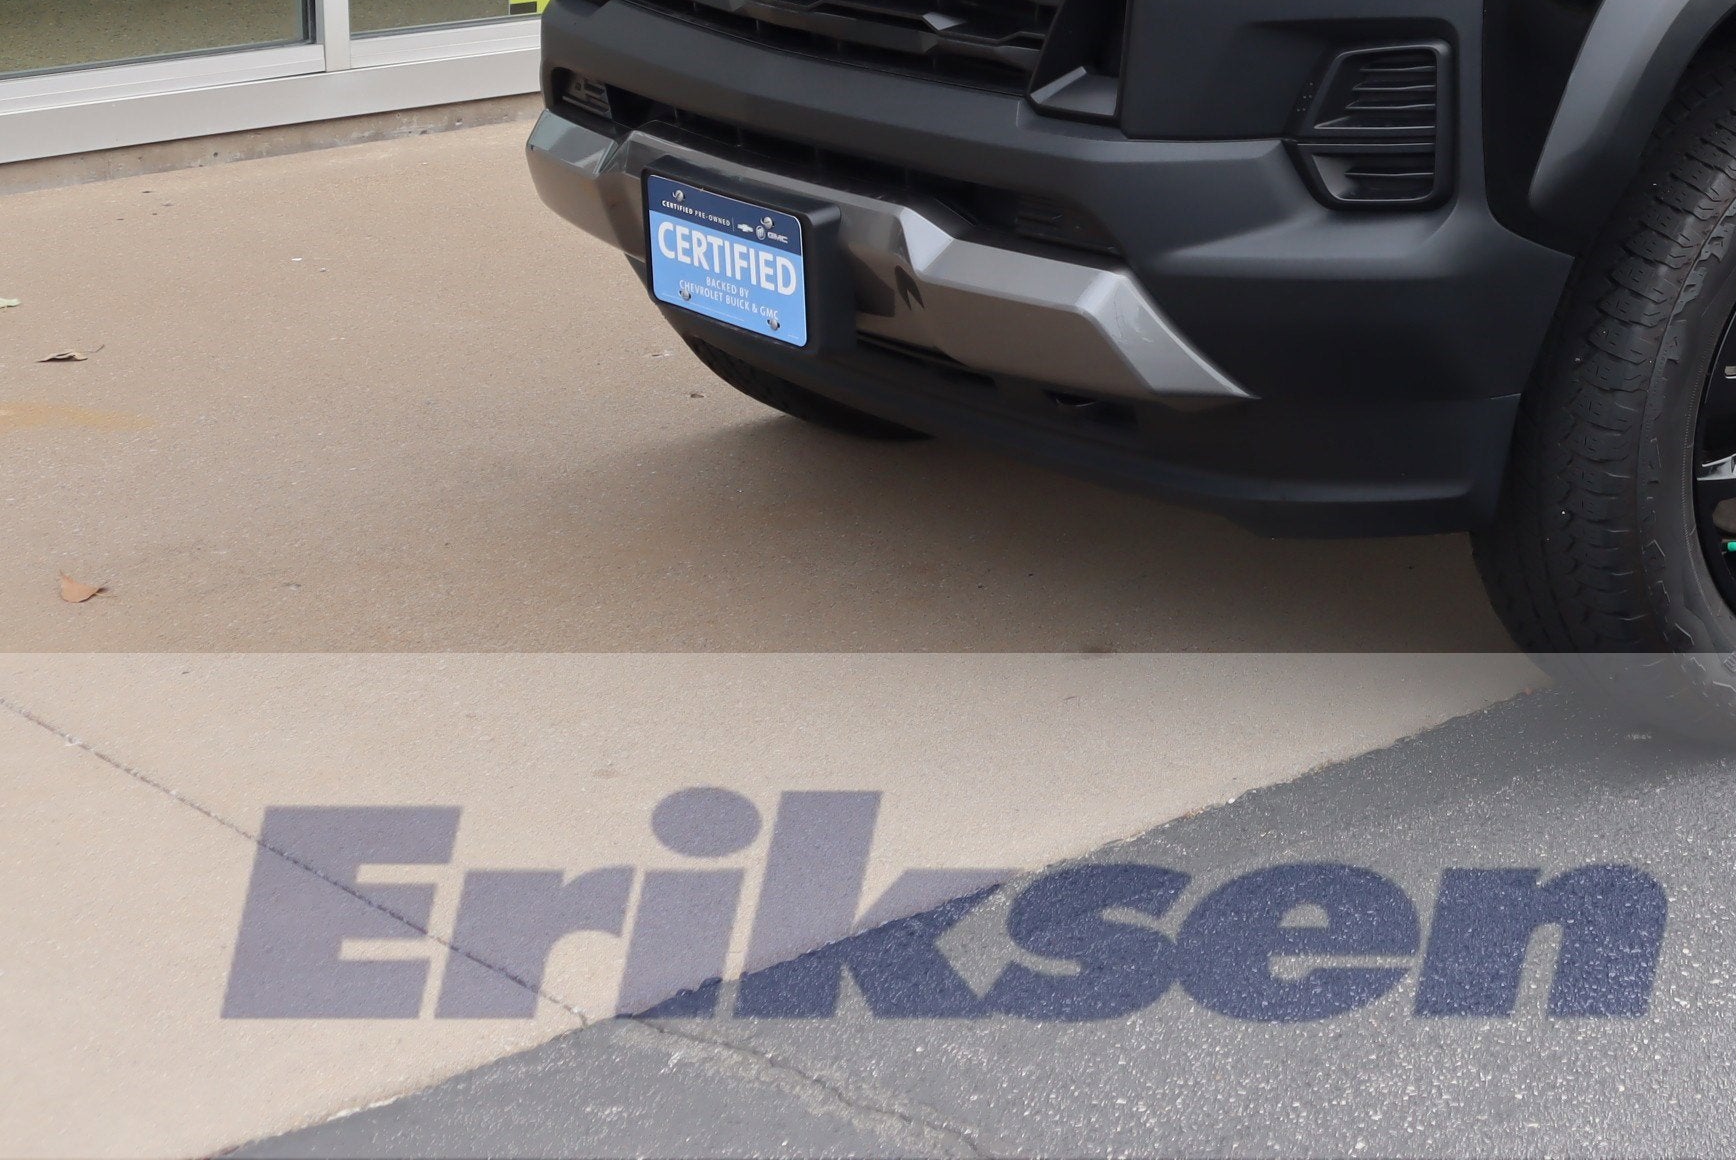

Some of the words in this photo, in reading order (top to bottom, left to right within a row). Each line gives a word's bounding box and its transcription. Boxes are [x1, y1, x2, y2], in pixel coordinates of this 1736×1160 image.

[661, 199, 694, 215] CERTIFIED
[694, 210, 731, 227] PRE-OWNED
[767, 231, 789, 244] GMC
[657, 221, 797, 296] CERTIFIED
[679, 279, 723, 302] CHEVROLET
[725, 294, 751, 313] BUICK
[760, 305, 779, 320] GMC
[705, 276, 737, 295] BACKED
[739, 287, 750, 299] BY
